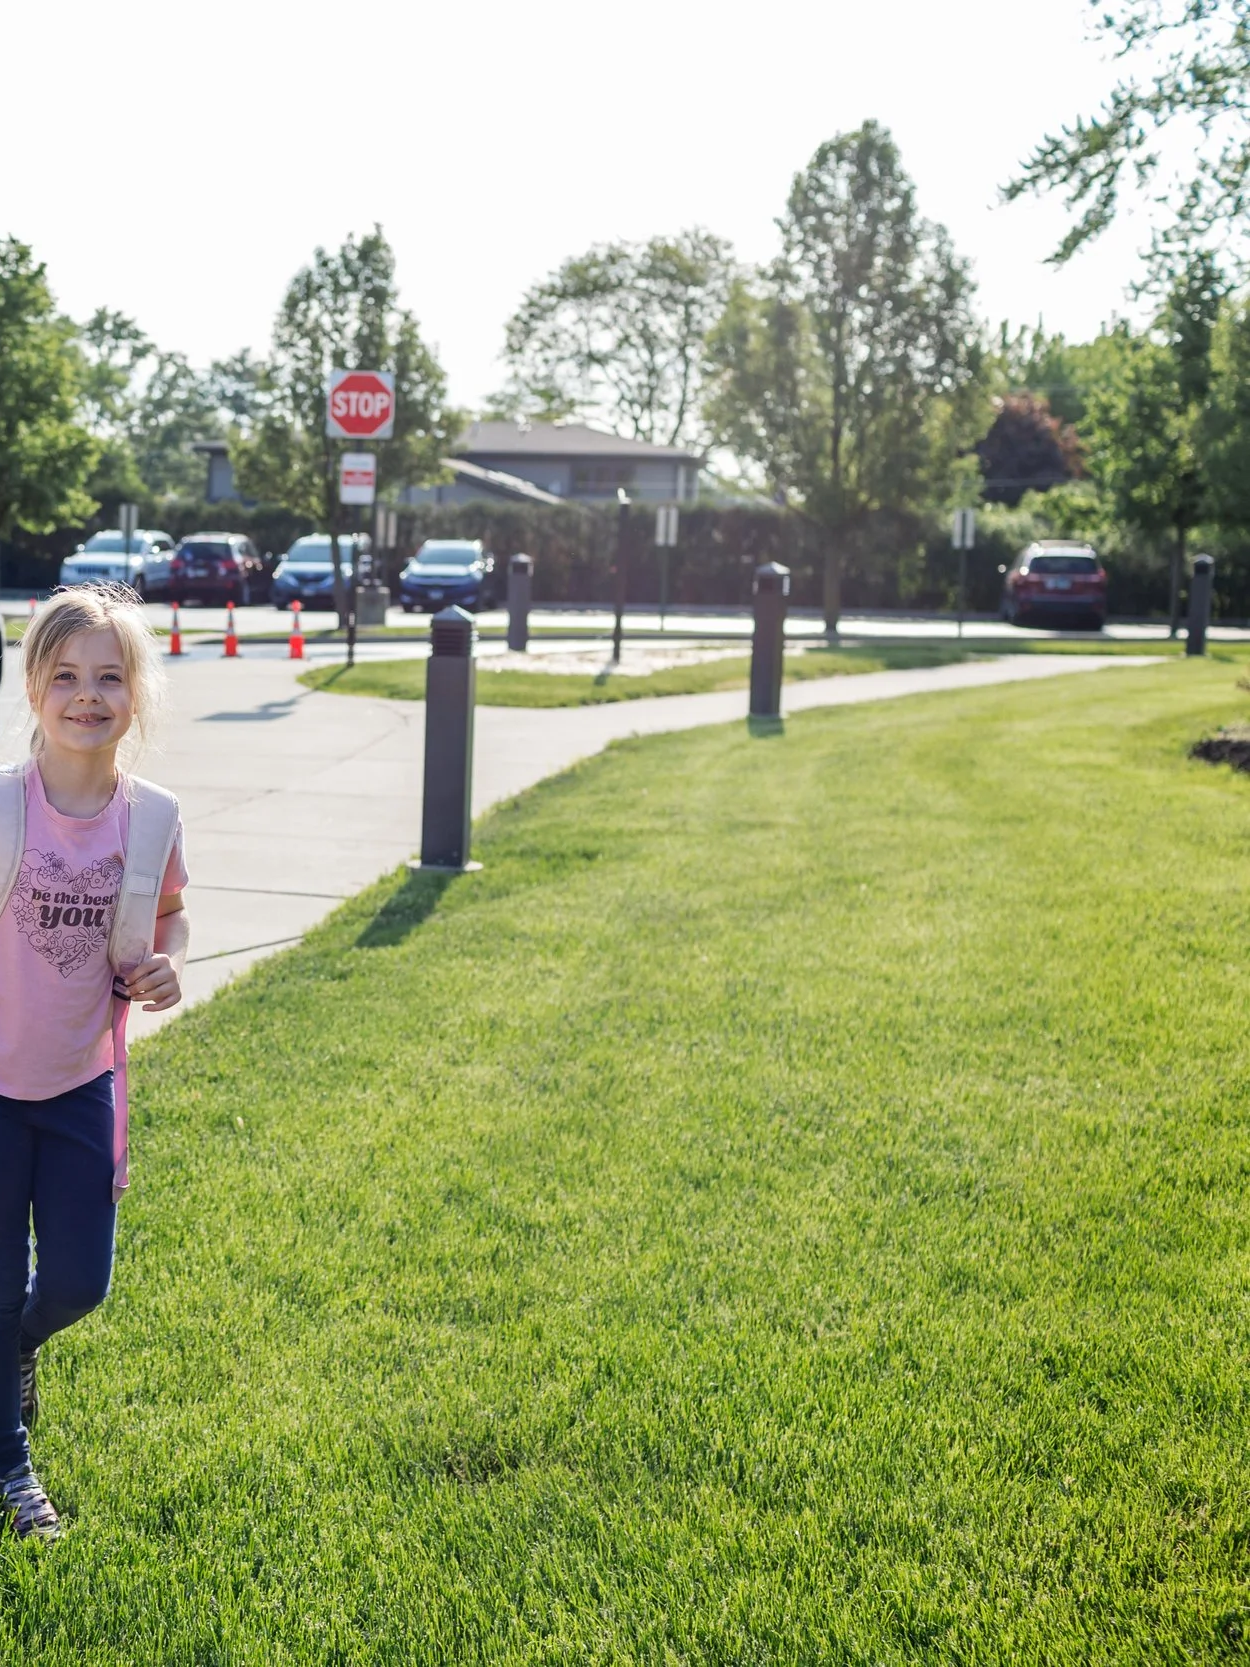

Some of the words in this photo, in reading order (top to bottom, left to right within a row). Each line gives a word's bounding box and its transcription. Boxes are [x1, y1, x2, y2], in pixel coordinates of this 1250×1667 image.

[333, 391, 390, 418] STOP
[31, 888, 51, 902] be
[53, 892, 80, 904] the
[82, 893, 113, 906] best
[39, 904, 105, 929] you
